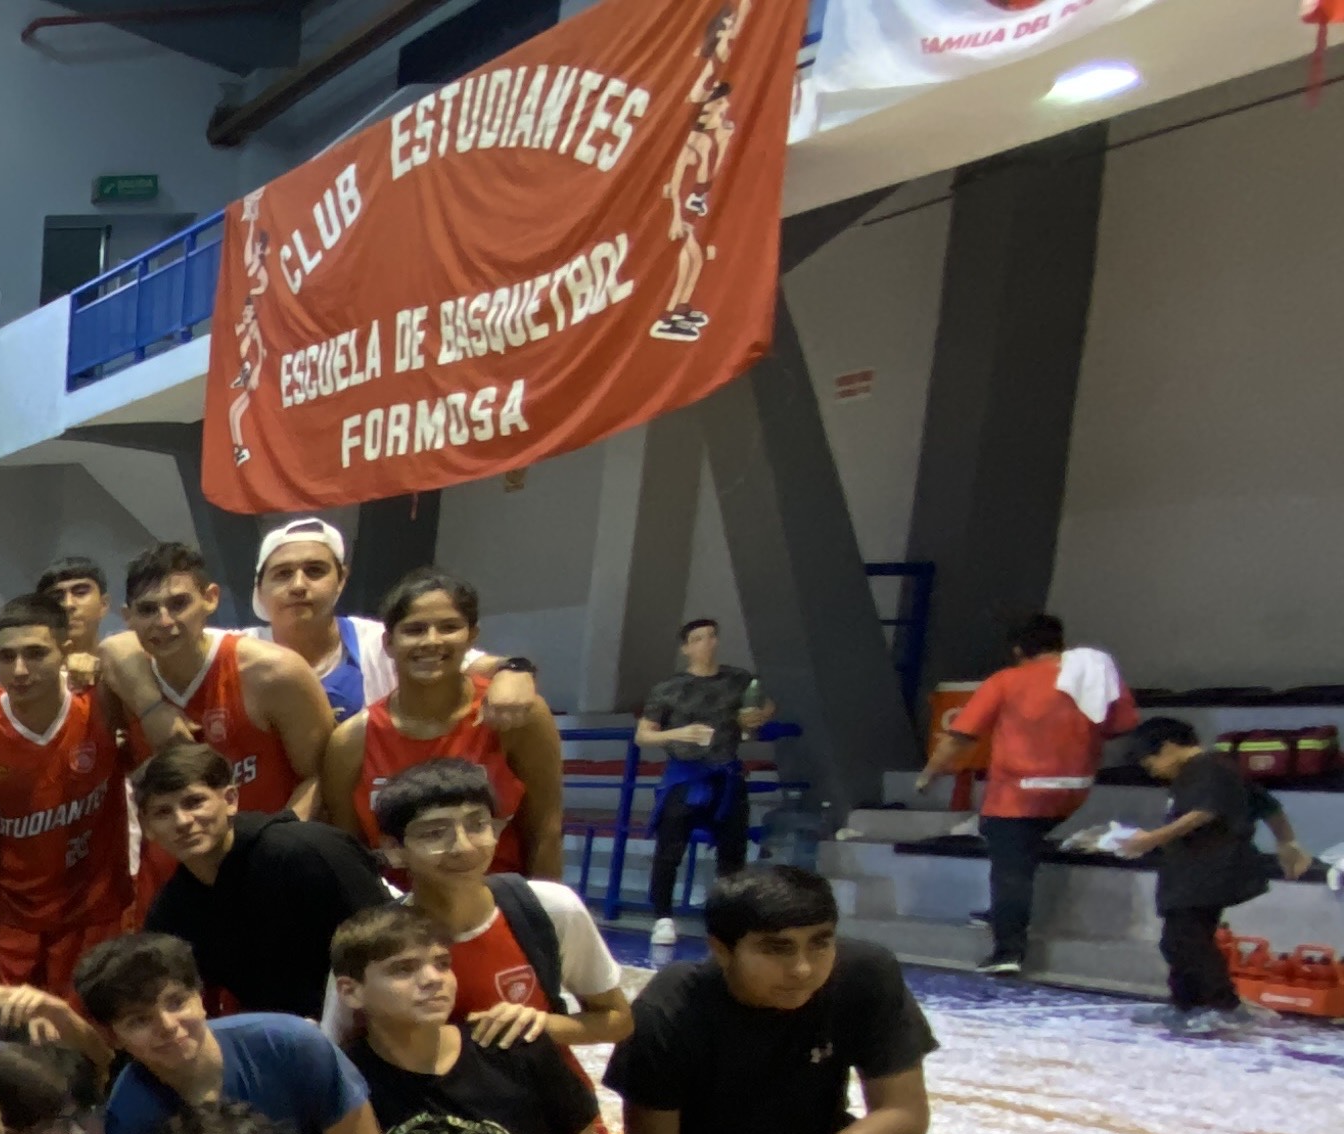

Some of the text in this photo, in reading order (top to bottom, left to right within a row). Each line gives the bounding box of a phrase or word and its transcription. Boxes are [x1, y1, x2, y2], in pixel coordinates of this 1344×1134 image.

[1013, 14, 1051, 39] DEL
[278, 64, 650, 297] CLUB ESTUDIANTES
[281, 232, 636, 410] ESCUELA DE BASQUETBOL
[341, 378, 530, 470] FORMOSA
